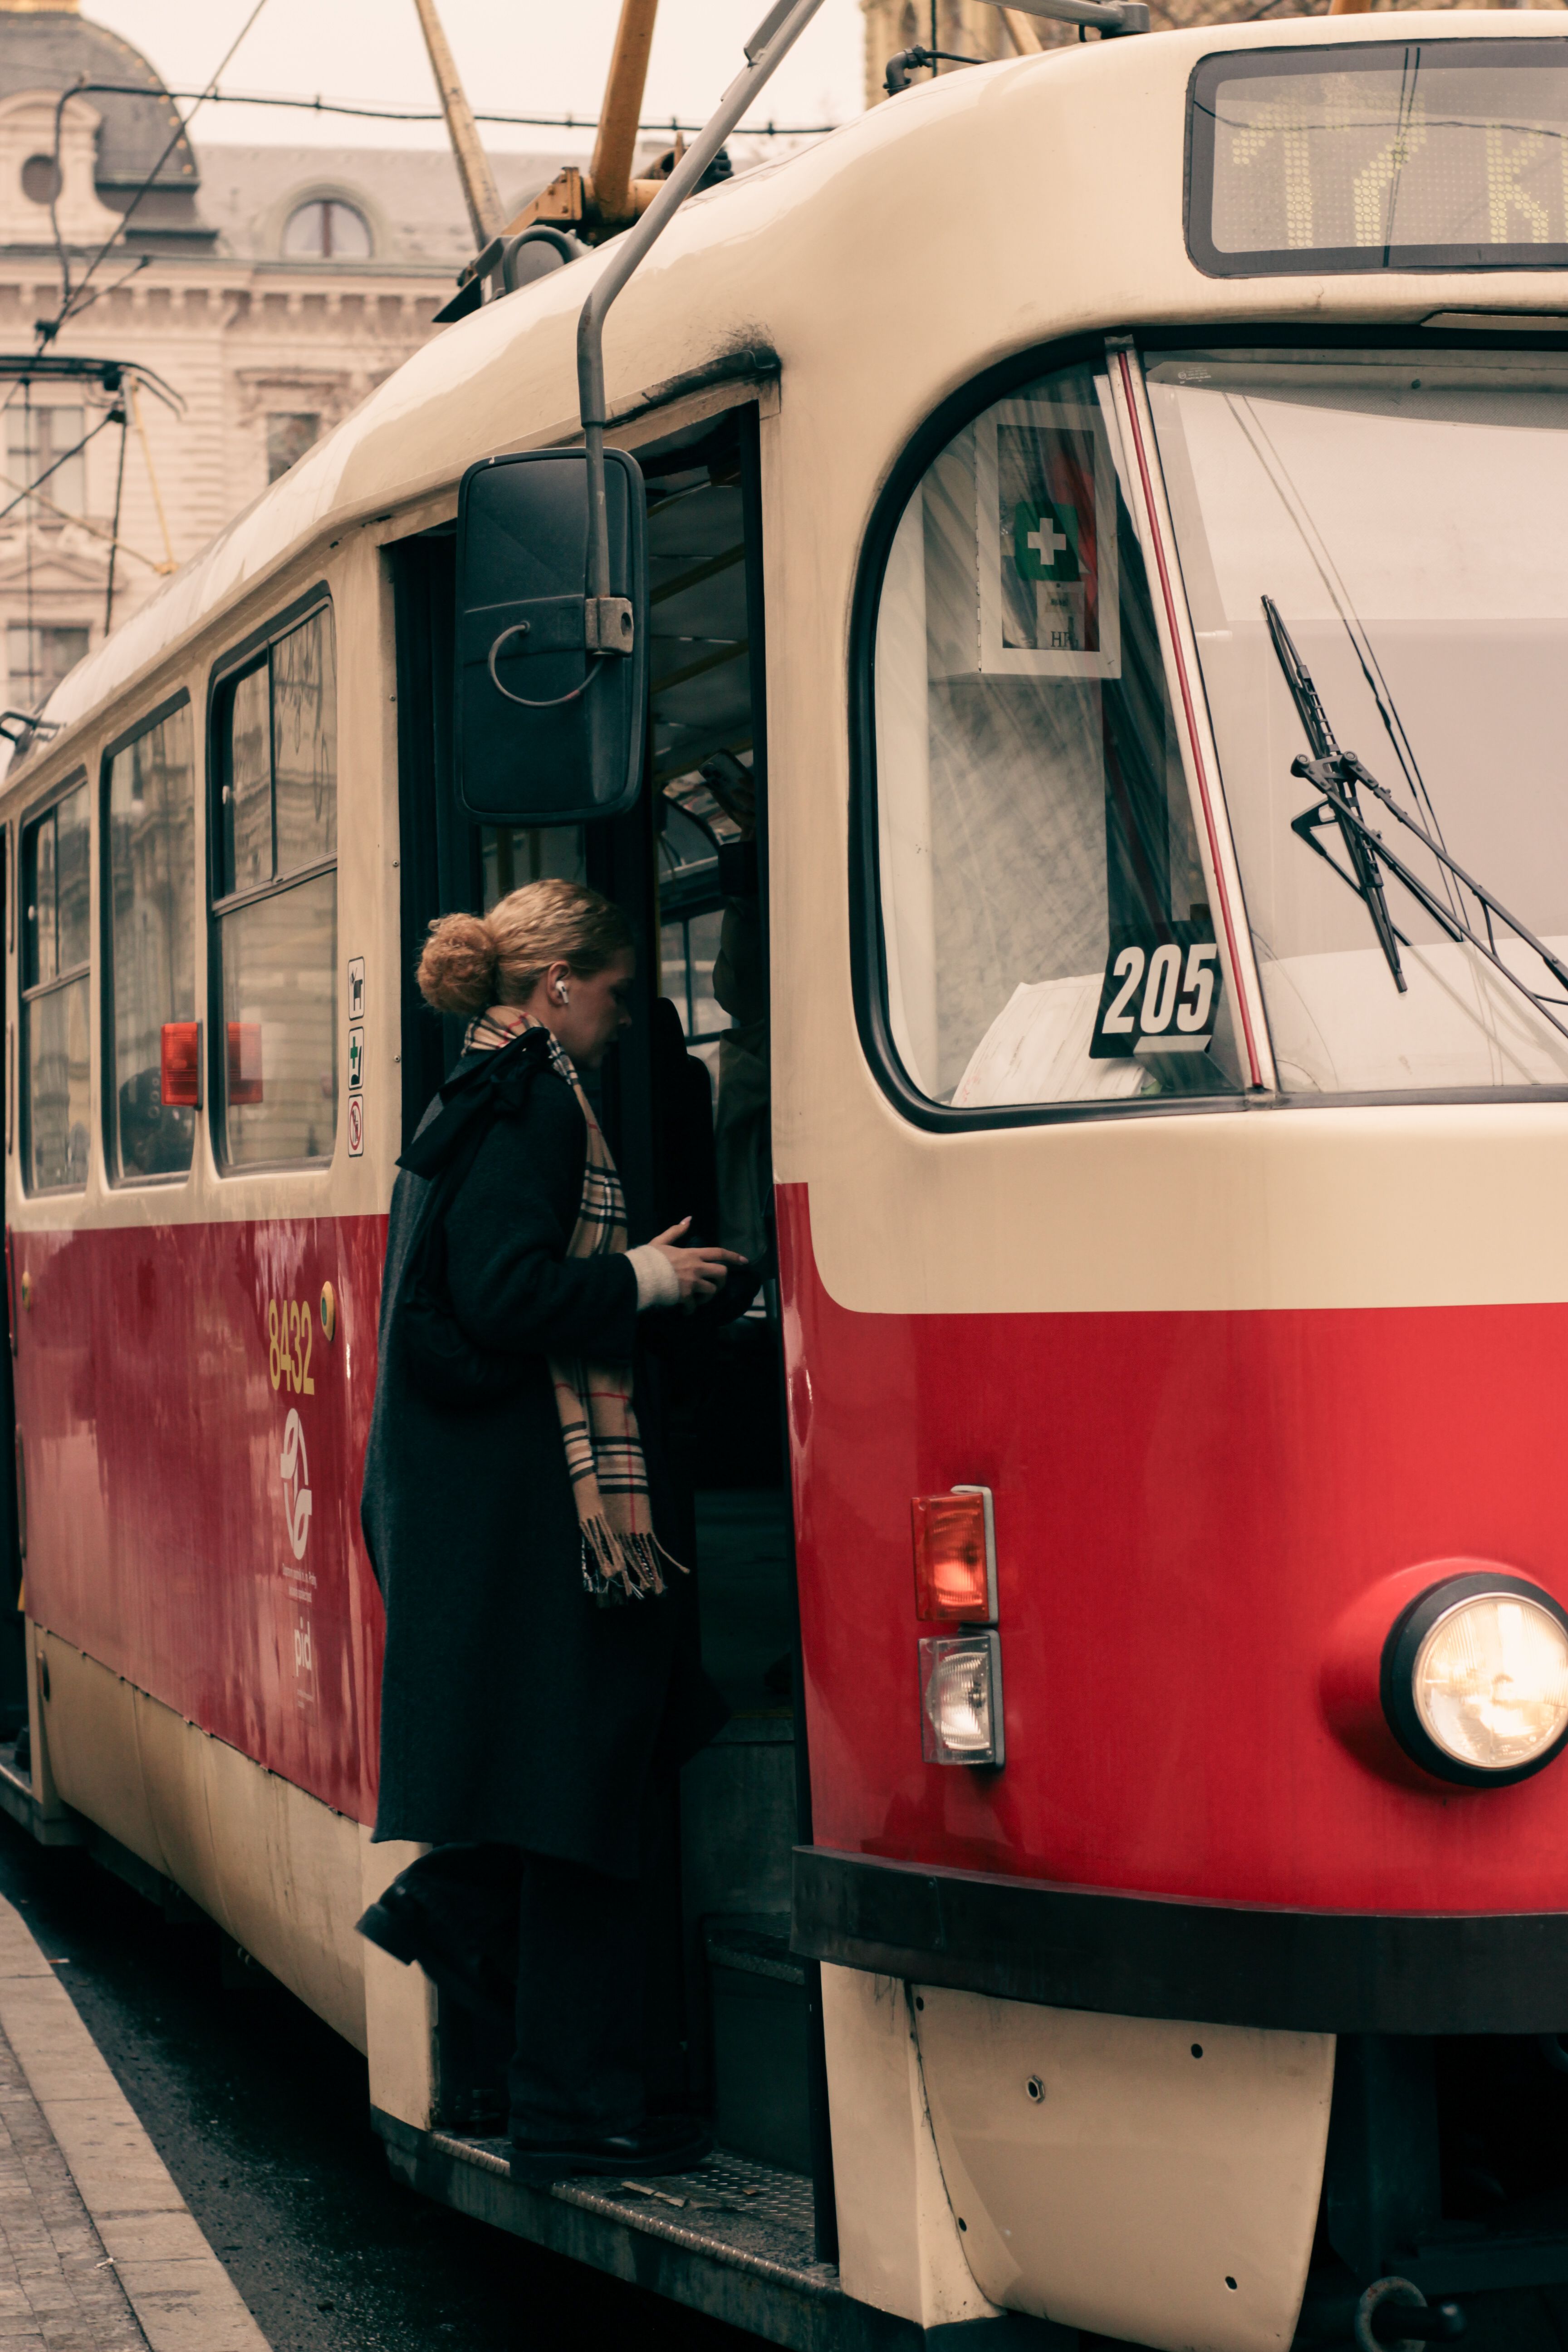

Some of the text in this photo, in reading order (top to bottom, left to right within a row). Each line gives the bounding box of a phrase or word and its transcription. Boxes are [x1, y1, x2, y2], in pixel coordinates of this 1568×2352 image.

[1232, 92, 1568, 248] 17 K
[1102, 944, 1217, 1034] 205
[269, 1298, 315, 1395] 8432
[294, 1616, 312, 1676] pid
